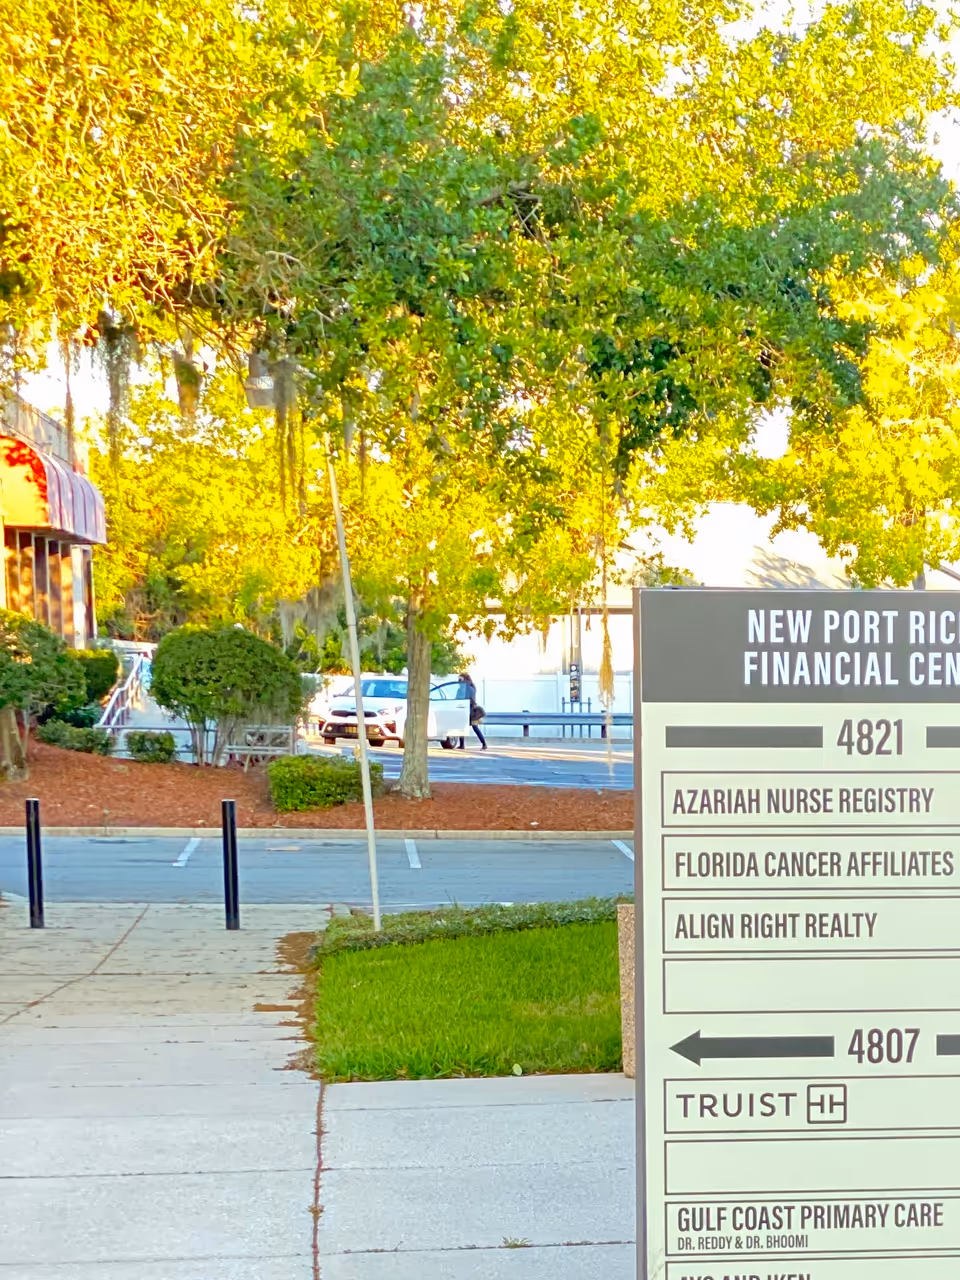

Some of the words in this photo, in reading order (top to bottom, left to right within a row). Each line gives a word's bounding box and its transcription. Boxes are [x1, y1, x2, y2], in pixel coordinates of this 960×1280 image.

[749, 610, 812, 643] NEW
[824, 610, 898, 643] PORT
[744, 652, 899, 685] FINANCIAL
[837, 719, 903, 755] 4821
[673, 788, 761, 814] AZARIAH
[767, 788, 834, 813] NURSE
[839, 787, 934, 813] REGISTRY
[675, 852, 759, 877] FLORIDA
[764, 852, 842, 877] CANCER
[847, 851, 954, 877] AFFILIATES
[675, 914, 734, 939] ALIGN
[740, 913, 800, 939] RIGHT
[805, 913, 878, 938] REALTY
[848, 1028, 920, 1063] 4807
[676, 1092, 797, 1118] TRUIST
[677, 1206, 728, 1231] GULF
[732, 1205, 795, 1230] COAST
[800, 1204, 889, 1229] PRIMARY
[894, 1203, 944, 1227] CARE
[678, 1237, 695, 1250] DR.
[698, 1236, 732, 1250] REDDY
[735, 1236, 743, 1249] &
[746, 1236, 763, 1249] DR.
[767, 1235, 809, 1249] BHOOMI
